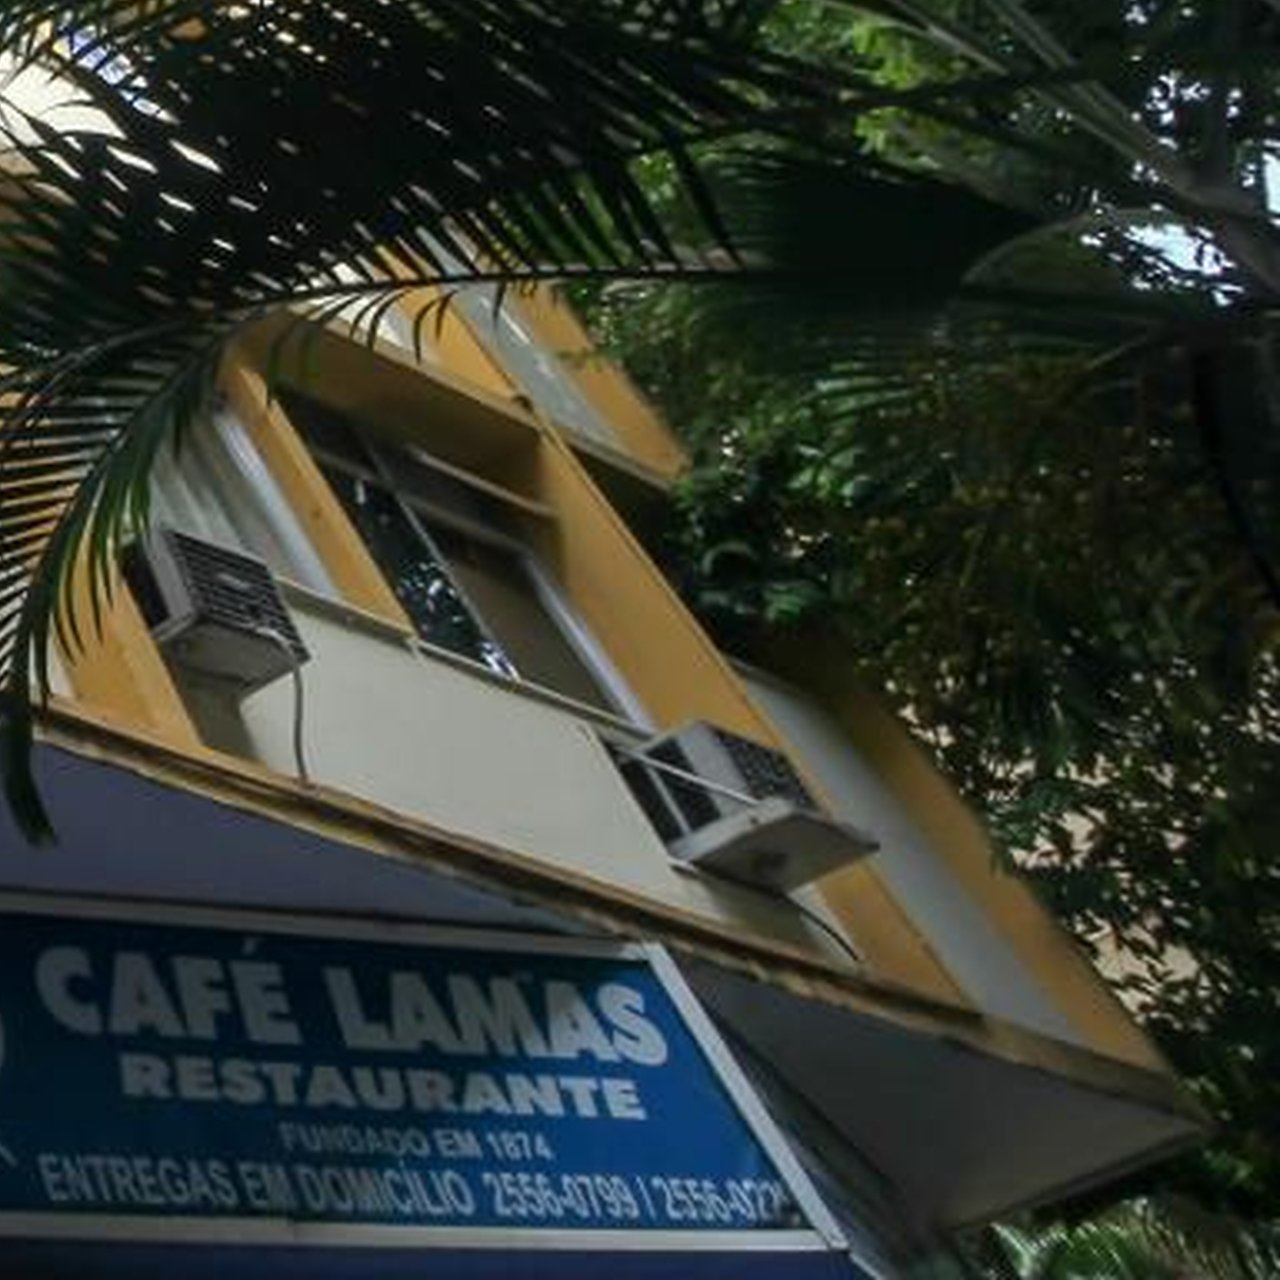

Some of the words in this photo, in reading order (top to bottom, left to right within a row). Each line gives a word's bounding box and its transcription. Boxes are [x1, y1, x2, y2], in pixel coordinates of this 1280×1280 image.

[36, 936, 304, 1045] CAFÉ
[324, 965, 669, 1067] LAMAS
[118, 1053, 647, 1120] RESTAURANTE
[279, 1123, 429, 1157] FUNDADO
[433, 1128, 482, 1159] EM
[486, 1131, 555, 1161] 1874
[38, 1153, 240, 1208] ENTREGAS
[242, 1162, 297, 1210] EM
[296, 1159, 476, 1217] DOMICÍLIO
[482, 1171, 640, 1220] 2556-0799
